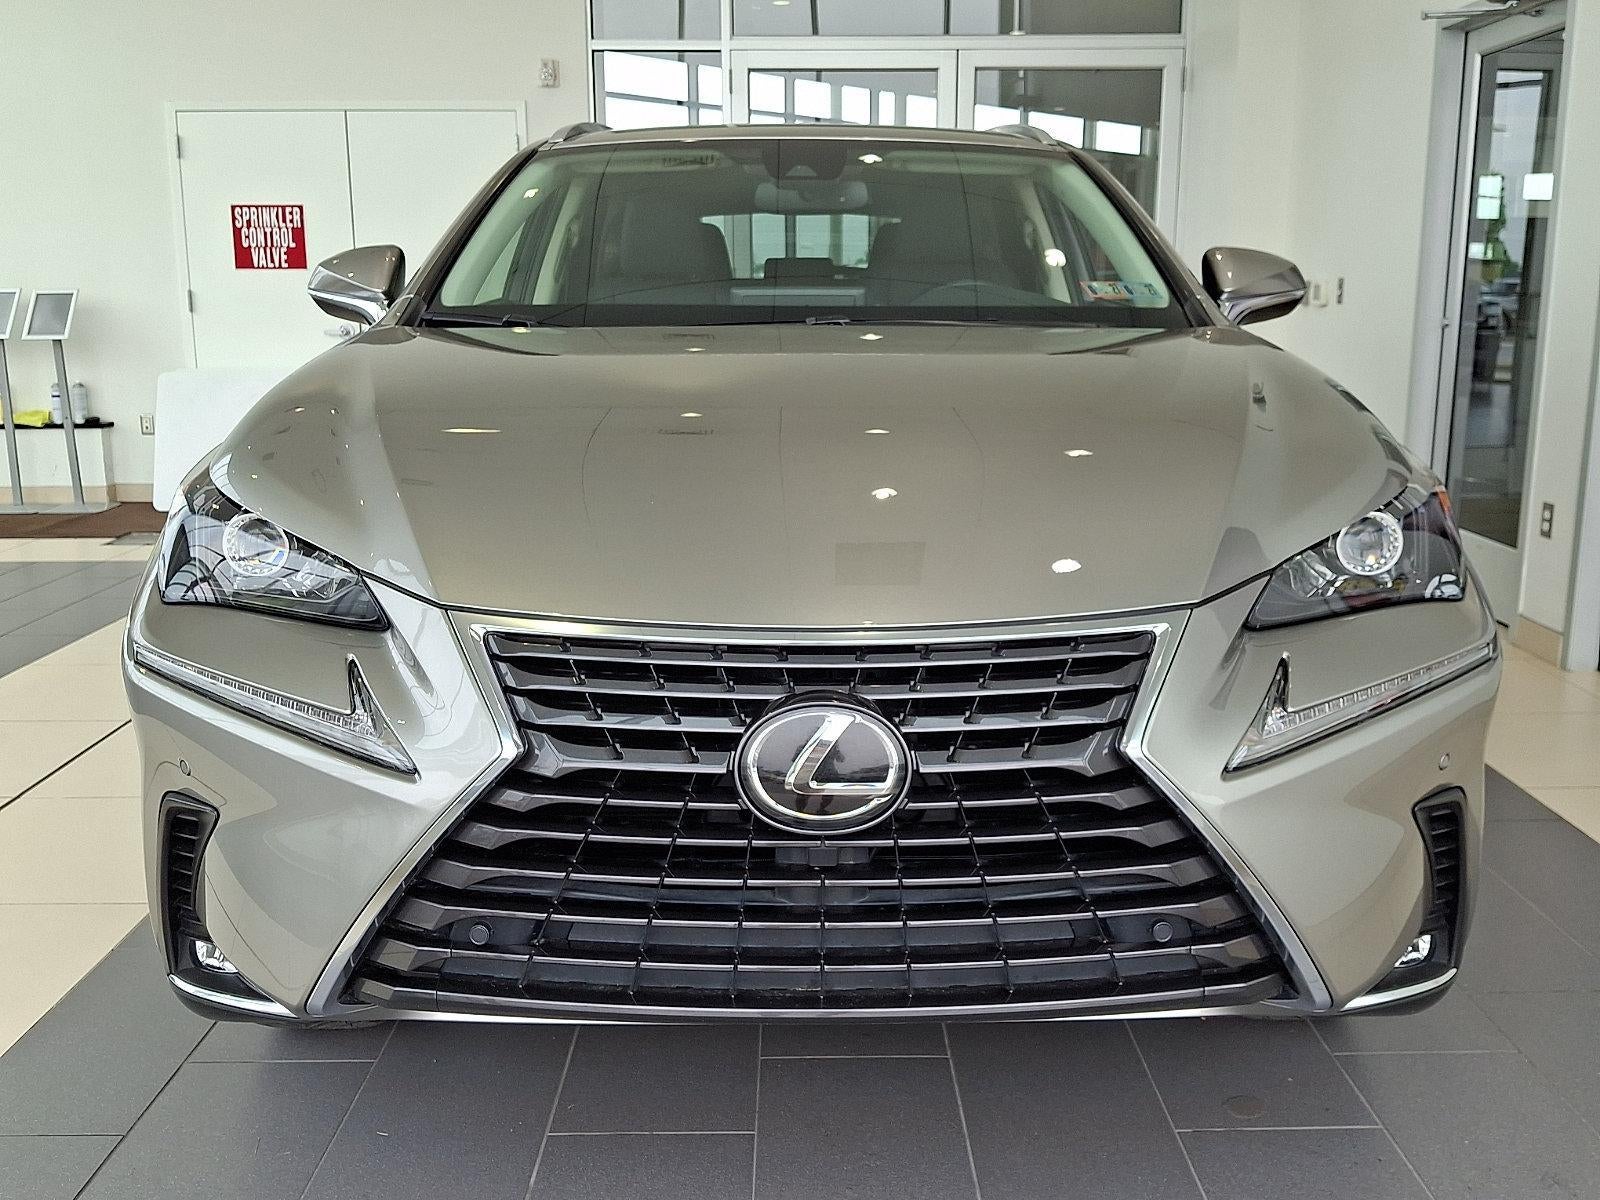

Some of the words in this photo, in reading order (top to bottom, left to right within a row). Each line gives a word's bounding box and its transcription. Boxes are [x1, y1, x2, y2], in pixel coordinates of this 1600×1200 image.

[234, 206, 301, 228] SPRINKLER
[241, 227, 296, 248] CONTROL
[251, 247, 288, 268] VALVE
